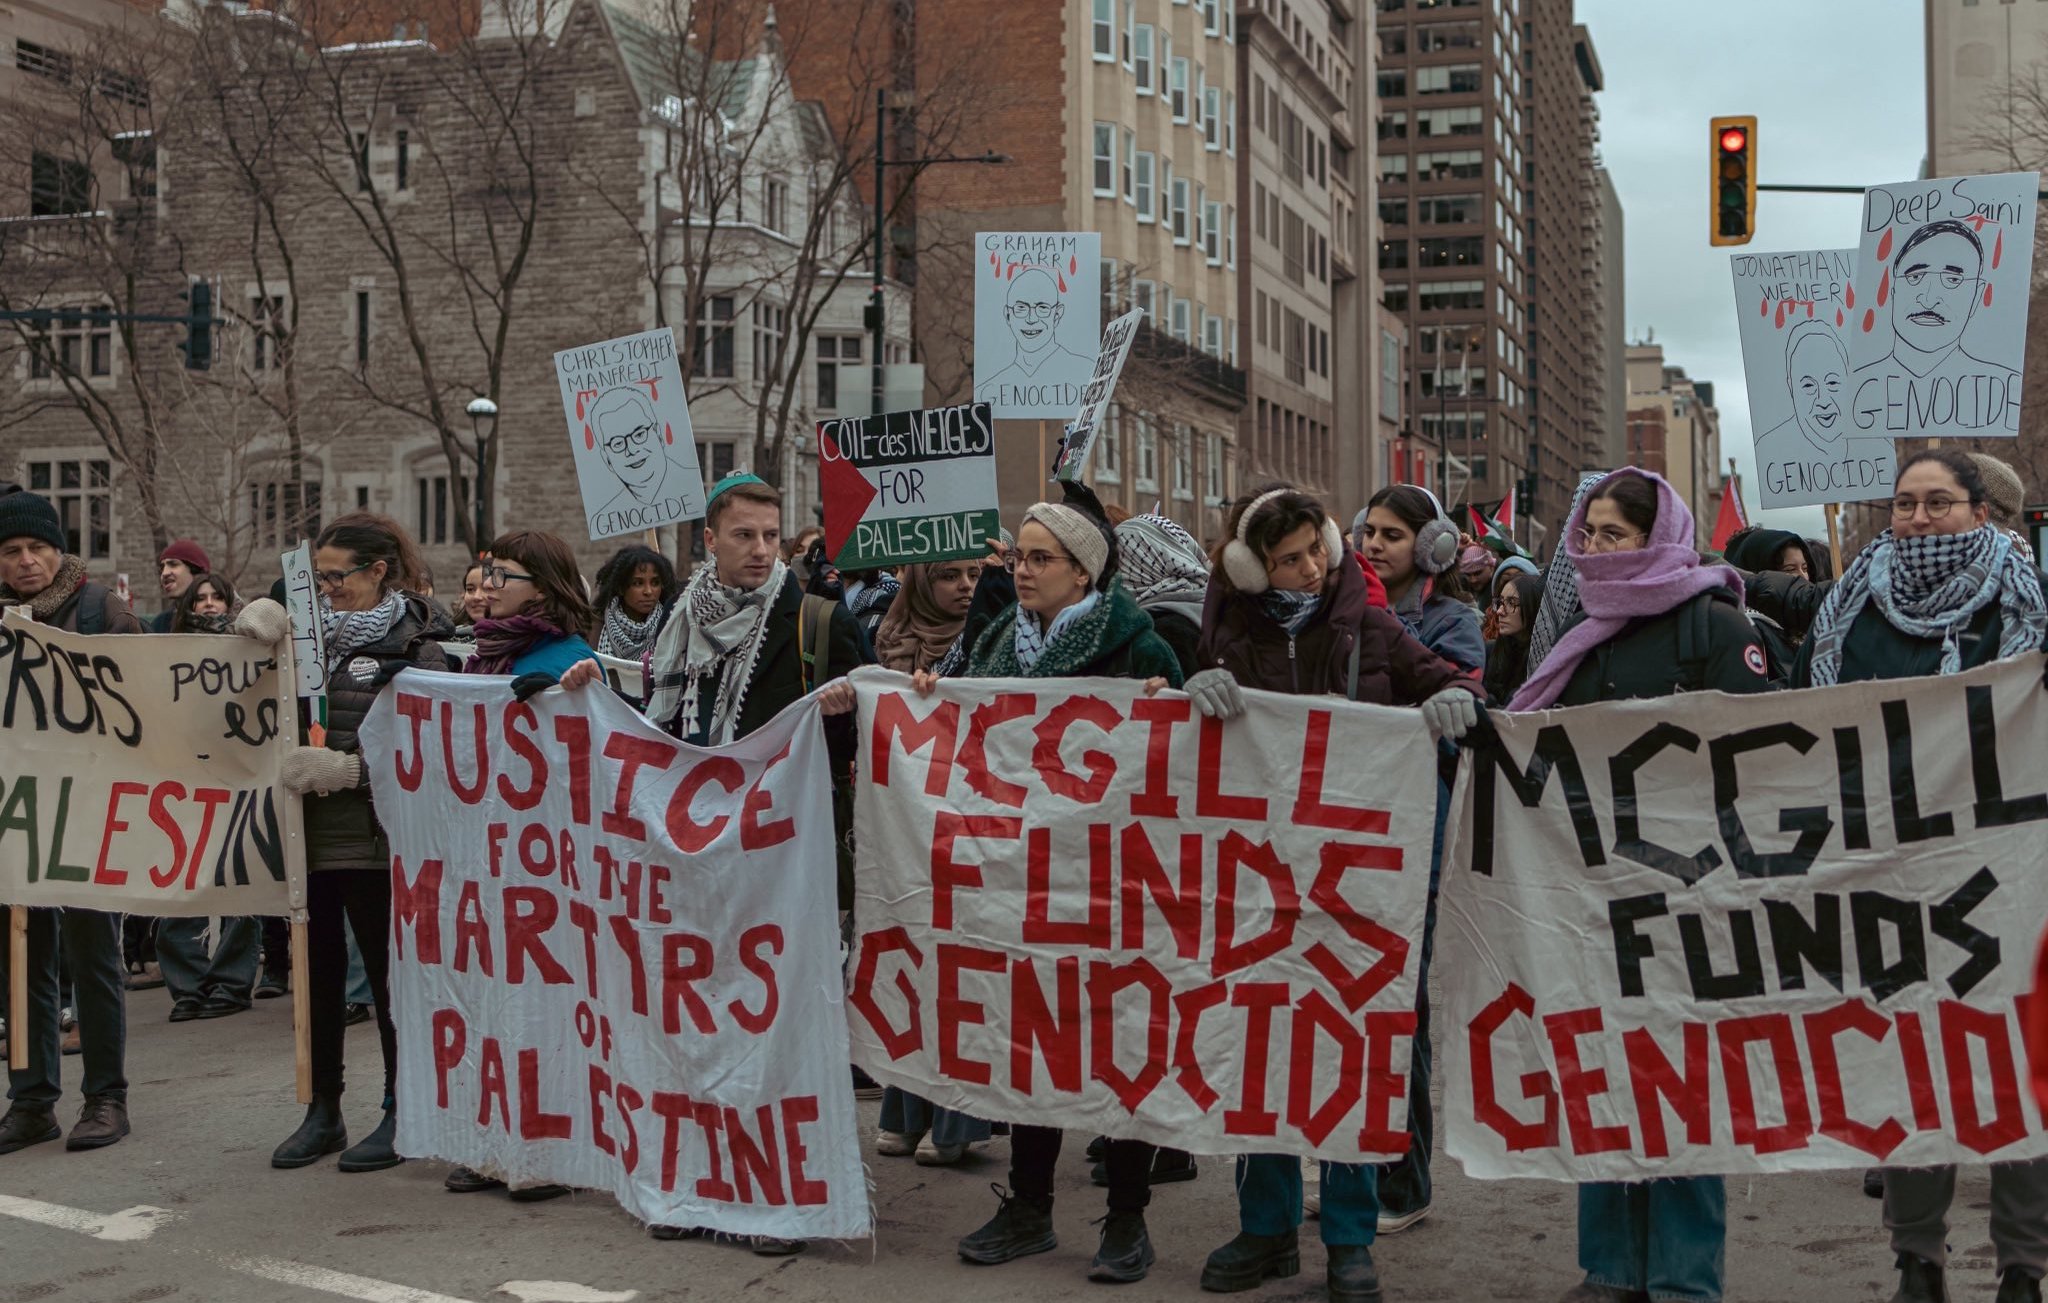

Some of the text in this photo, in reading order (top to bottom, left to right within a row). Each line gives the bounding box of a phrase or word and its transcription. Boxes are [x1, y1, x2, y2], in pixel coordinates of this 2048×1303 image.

[1949, 178, 2022, 225] Saini
[984, 234, 1076, 252] GRAHAM
[1006, 251, 1063, 269] CARR
[1735, 251, 1851, 280] JONATHAN
[1759, 281, 1844, 304] WENER
[561, 333, 676, 374] CHRISTOPHER
[567, 360, 663, 393] MANFREDI
[1852, 373, 2020, 432] GENOCIDE
[878, 468, 926, 508] FOR
[1766, 457, 1892, 495] GENOCIDE
[596, 494, 699, 536] GENOCIDE
[856, 512, 986, 560] PALESTINE
[394, 691, 798, 854] JUSTICE
[871, 691, 1392, 835] MCGILL
[1471, 684, 2048, 887] MCGILL
[0, 774, 287, 891] ALESTIN
[487, 822, 673, 925] FOR THE
[931, 810, 1410, 1014] FUNDS
[1608, 865, 2002, 1004] FUNDS
[391, 853, 785, 1036] MARTYRS
[574, 1000, 612, 1062] OF
[847, 925, 1418, 1154] GENOCIDE
[431, 1007, 829, 1206] PALESTINE
